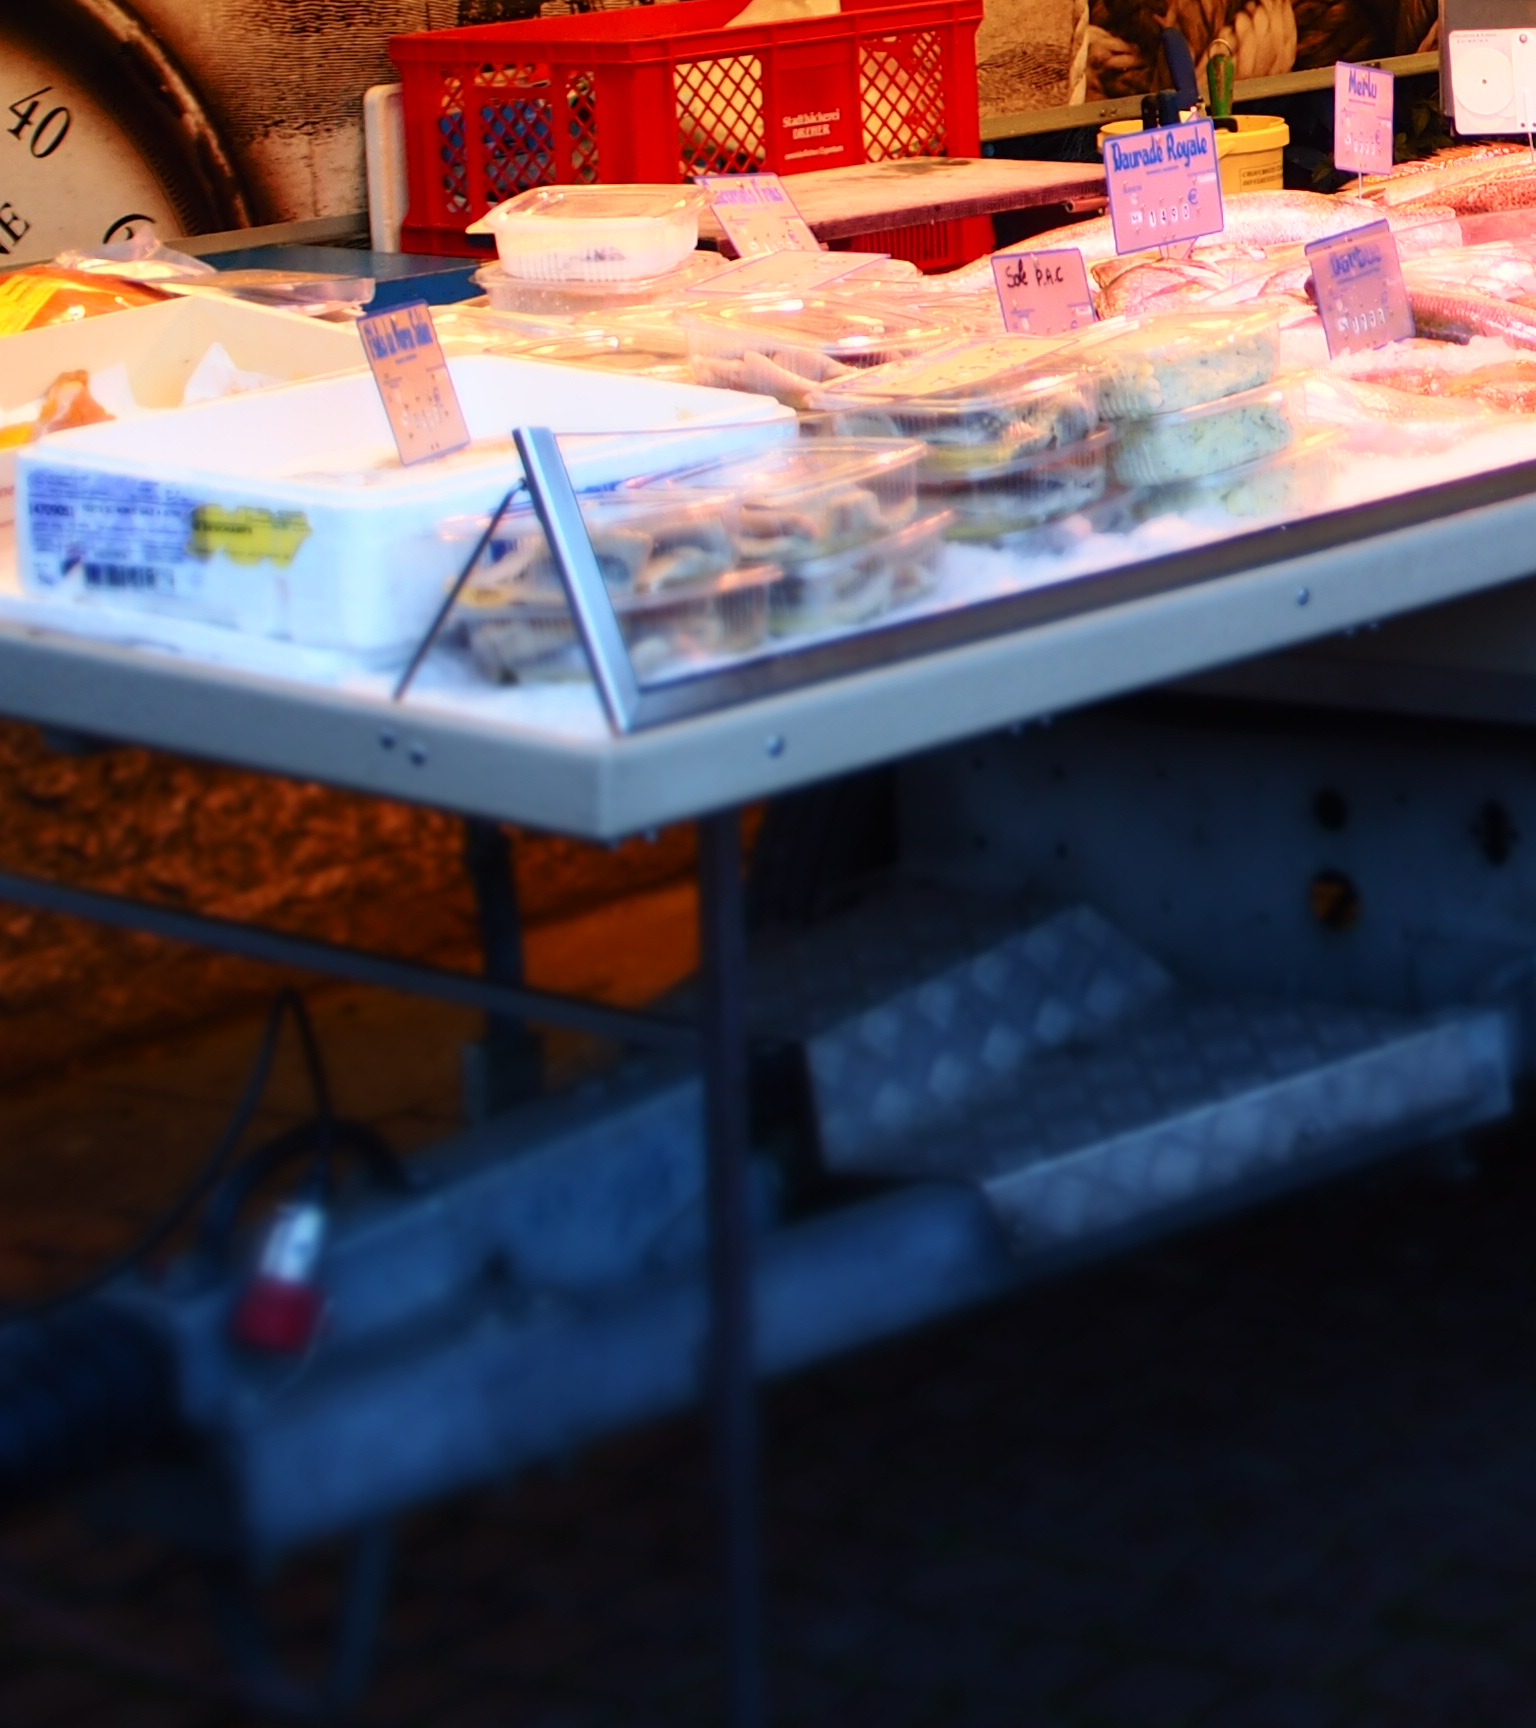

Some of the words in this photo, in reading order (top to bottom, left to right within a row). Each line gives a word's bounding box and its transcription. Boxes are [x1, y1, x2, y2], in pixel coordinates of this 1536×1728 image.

[7, 85, 71, 159] 40
[1111, 135, 1163, 172] Daurade
[1165, 125, 1208, 168] Royale
[1005, 258, 1028, 289] Sole
